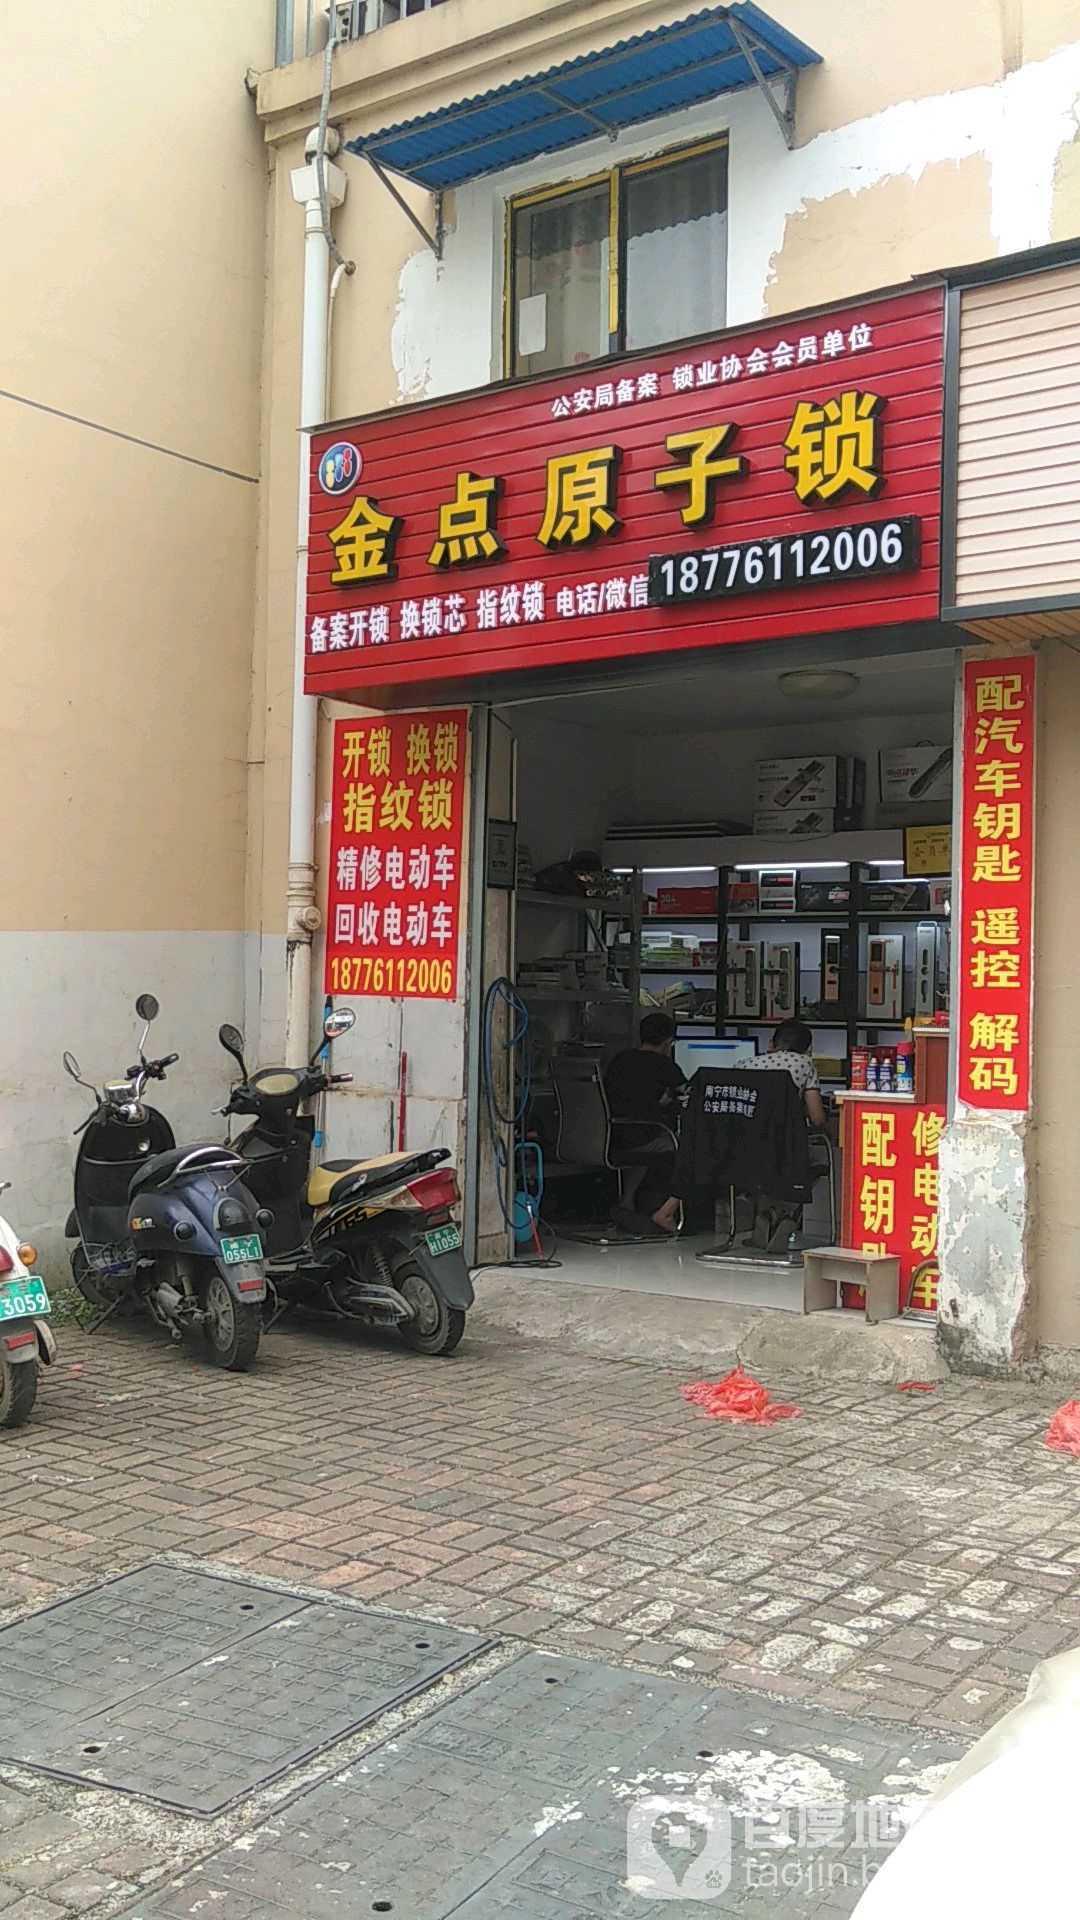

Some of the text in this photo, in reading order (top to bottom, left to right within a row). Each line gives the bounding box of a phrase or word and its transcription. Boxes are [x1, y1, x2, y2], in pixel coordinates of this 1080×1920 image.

[550, 322, 873, 418] 公安局备案 锁业协会会员单位
[327, 391, 881, 583] 金点原子锁
[310, 523, 903, 653] 备案开锁 换锁芯 指纹锁 电话/微信 18776112006
[342, 720, 459, 778] 开锁 换锁
[343, 777, 453, 833] 指纹锁
[336, 844, 456, 891] 精修电动车
[968, 674, 1025, 1095] 配汽车钥匙 遥控 解码
[334, 901, 453, 948] 回收电动车
[331, 957, 453, 994] 18776112006
